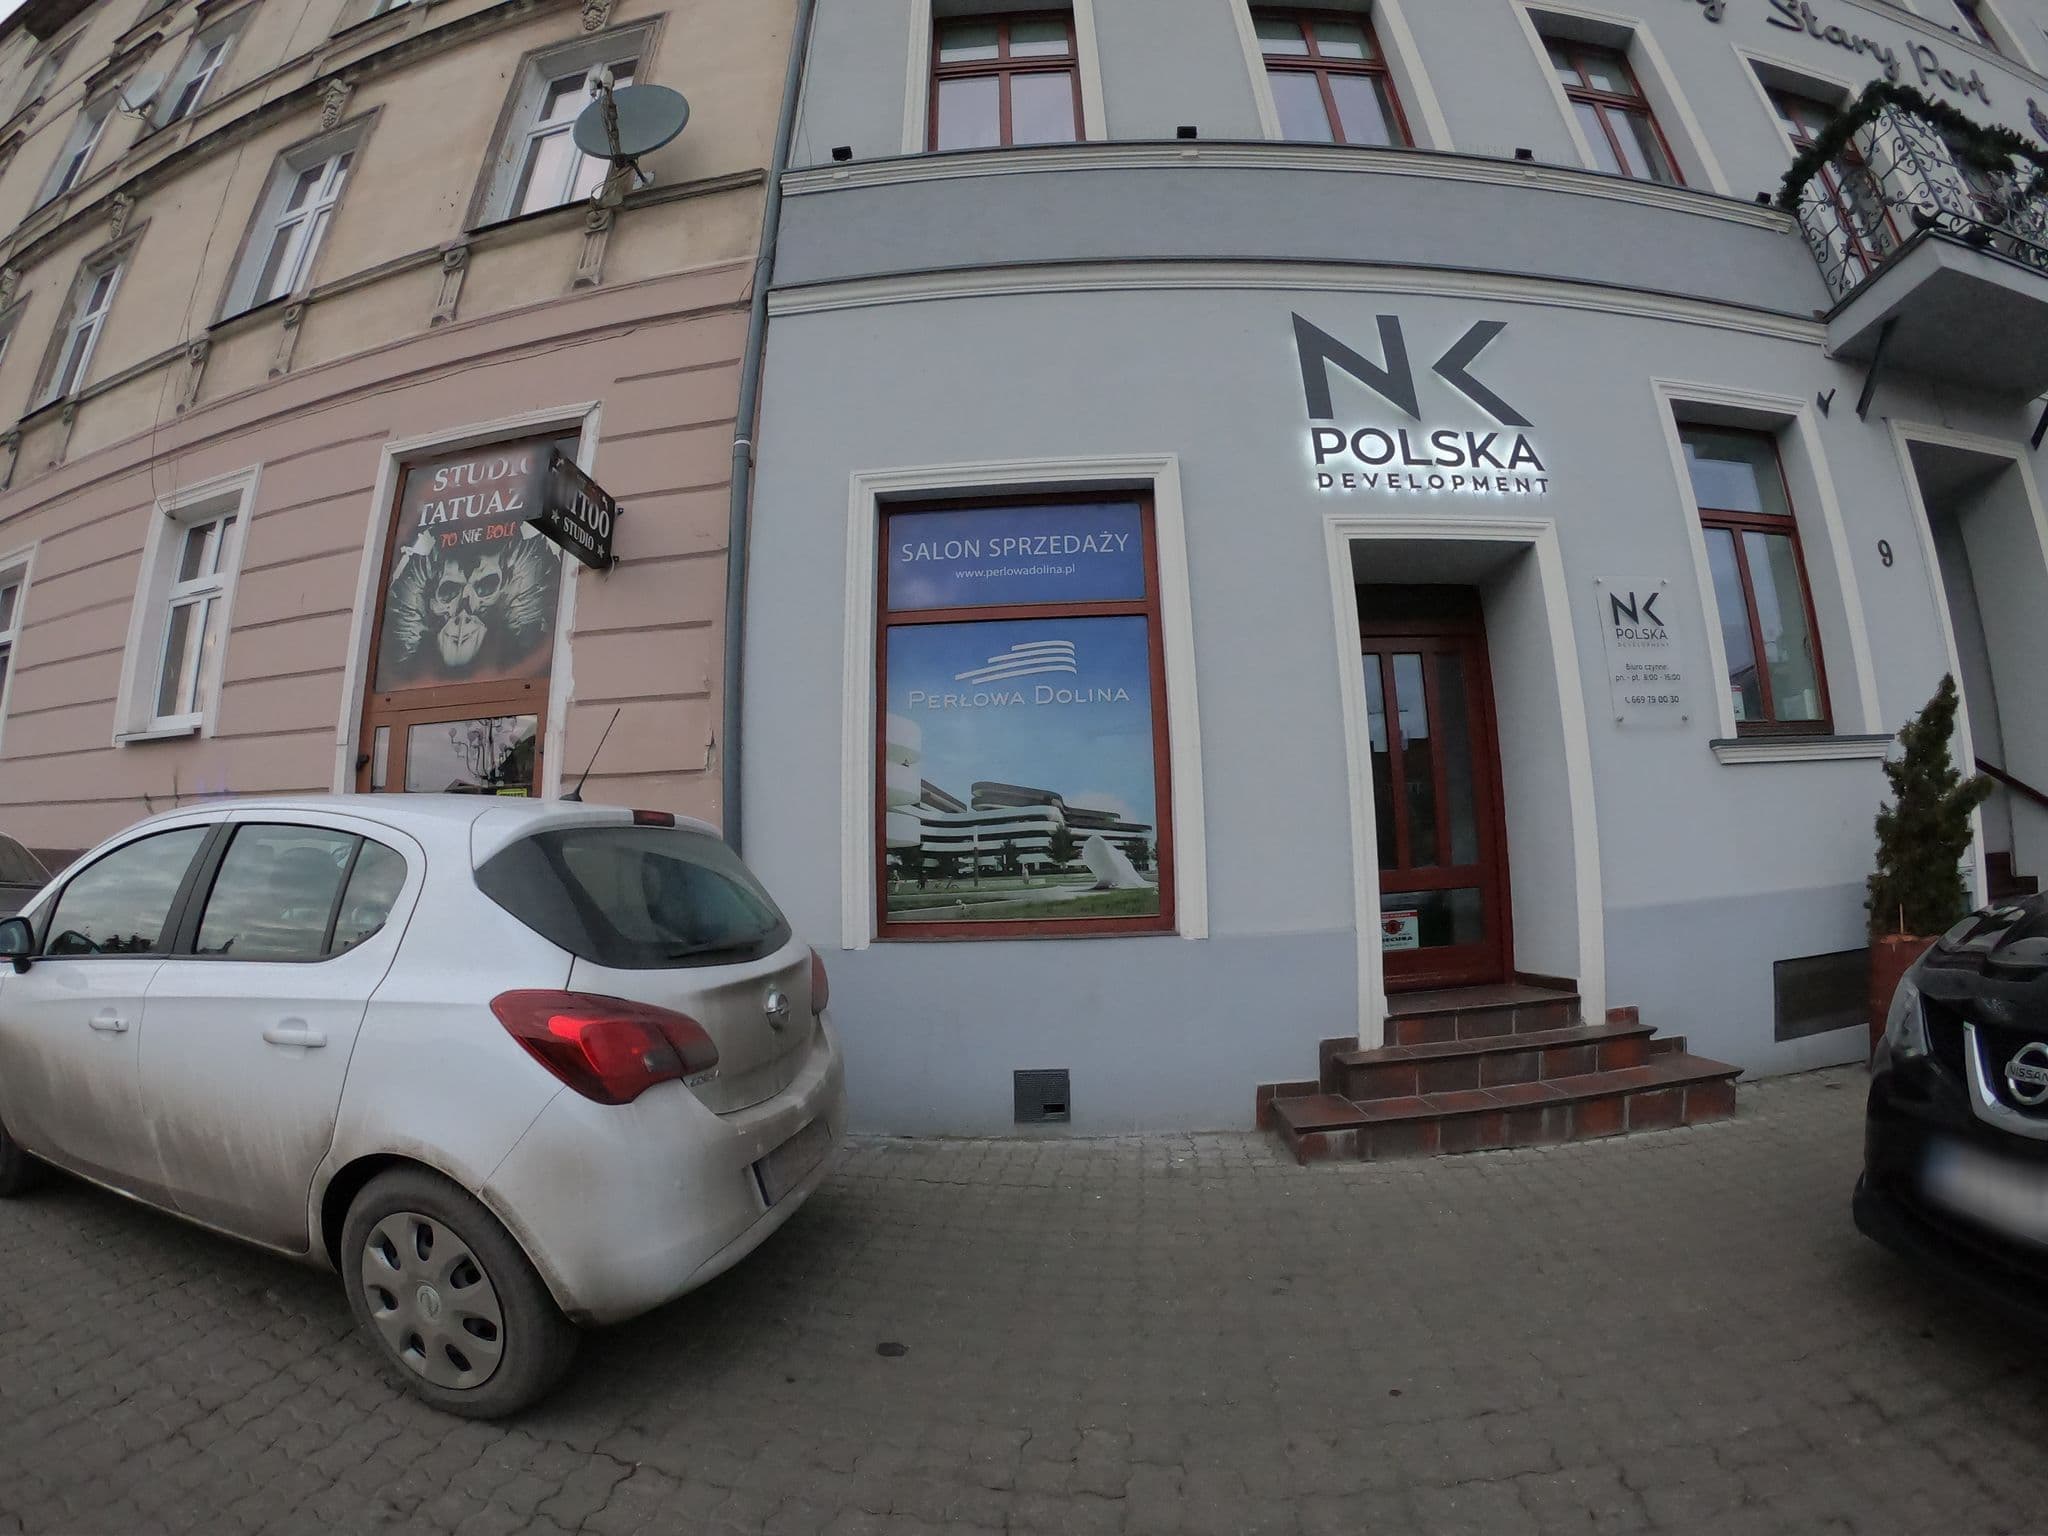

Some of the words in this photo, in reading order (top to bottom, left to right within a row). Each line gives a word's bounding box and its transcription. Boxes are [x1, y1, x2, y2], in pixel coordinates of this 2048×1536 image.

[1905, 39, 1991, 106] Port
[1291, 311, 1535, 427] NK
[1311, 427, 1545, 472] POLSKA
[1318, 472, 1549, 493] DEVELOPMENT
[441, 532, 458, 548] TO
[461, 528, 483, 544] NIE
[562, 516, 594, 551] STUDIO
[901, 539, 980, 562] SALON
[989, 530, 1129, 557] SPRZEDAŻY
[1878, 539, 1893, 568] 9
[955, 563, 1075, 579] www.perlowadolina.pl
[1609, 592, 1664, 626] NK
[1615, 628, 1668, 640] POLSKA
[1631, 695, 1646, 704] 669
[2010, 1064, 2048, 1082] NISSAN
